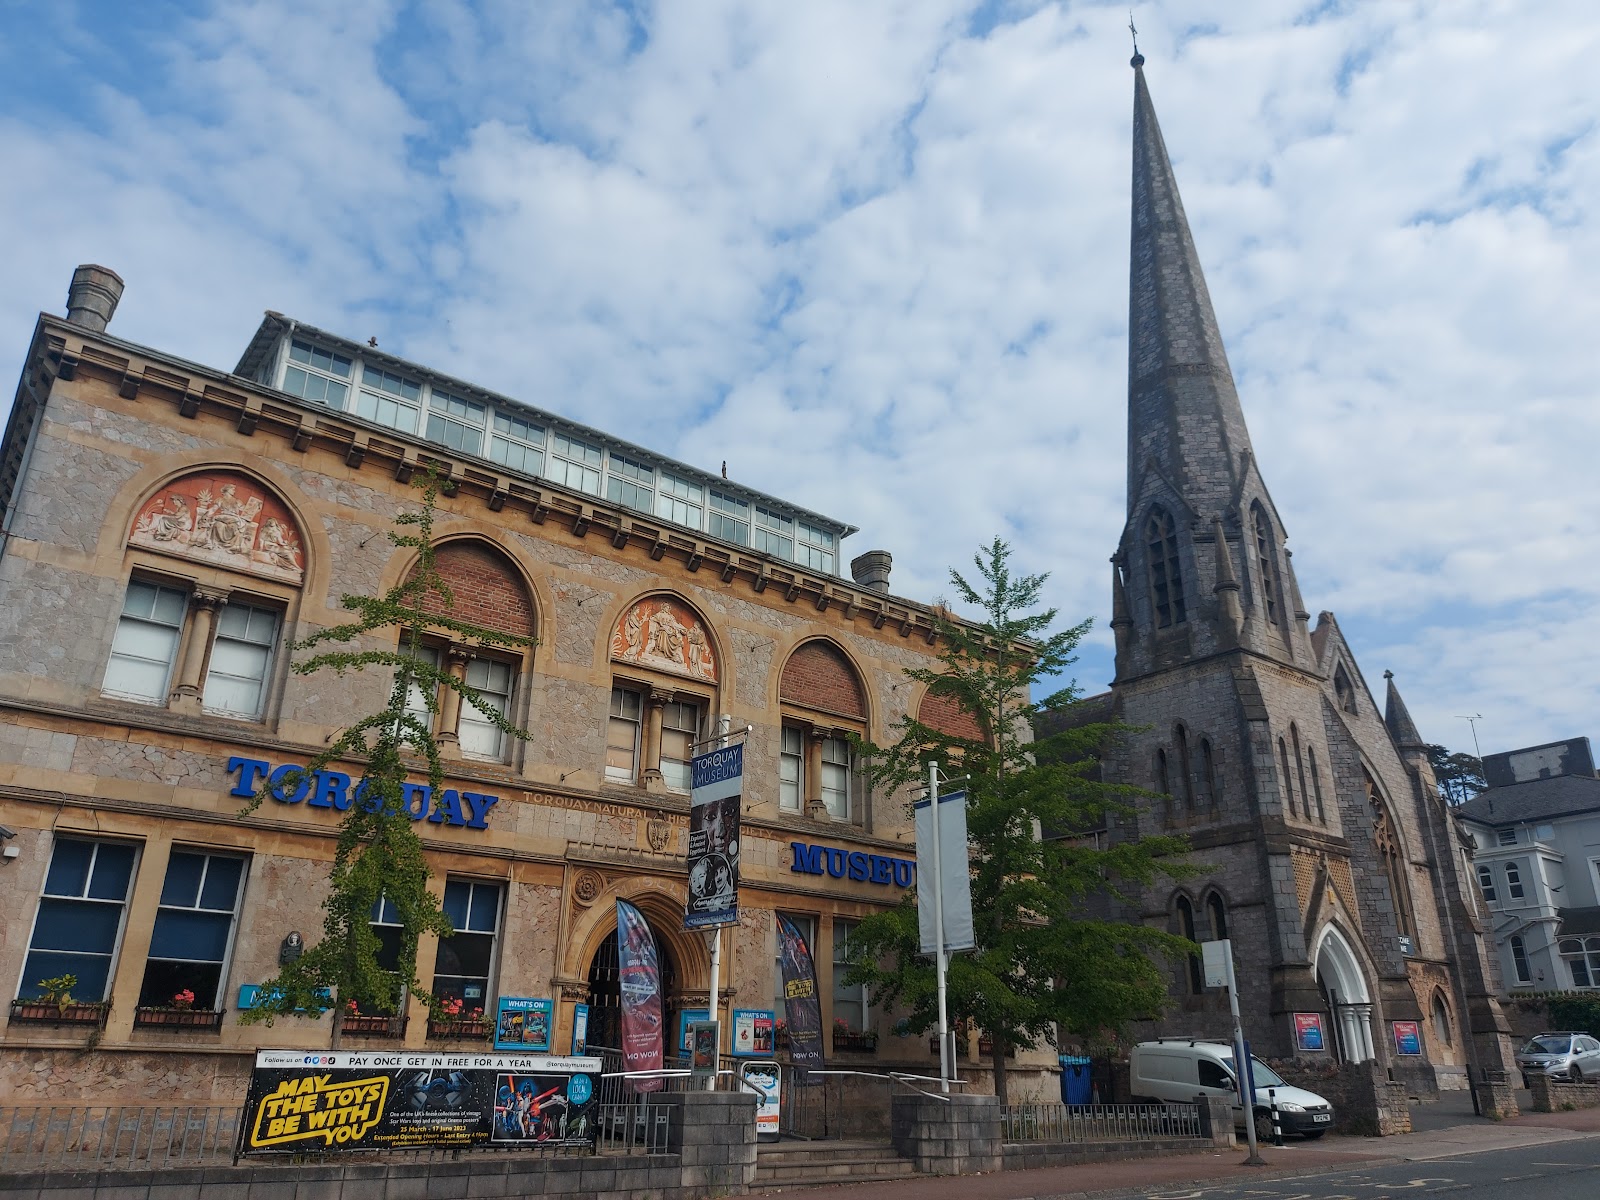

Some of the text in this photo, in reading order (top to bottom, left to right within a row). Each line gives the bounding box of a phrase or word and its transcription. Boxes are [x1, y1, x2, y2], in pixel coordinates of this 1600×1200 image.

[696, 748, 739, 771] TORQUAY
[696, 763, 738, 786] MUSEUM
[523, 791, 592, 811] TORQUAY
[593, 800, 648, 819] NATURAL
[791, 842, 916, 888] MUSEU
[508, 1000, 545, 1009] WHAT'S ON
[349, 1057, 531, 1067] PAY ONCE GET IN FREE FOR A YEAR
[277, 1073, 332, 1098] MAY
[572, 1084, 587, 1094] LOCAL
[267, 1083, 382, 1118] THE TOYS
[267, 1102, 371, 1138] BE WITH
[325, 1122, 367, 1146] YOU
[399, 1133, 422, 1141] Opening
